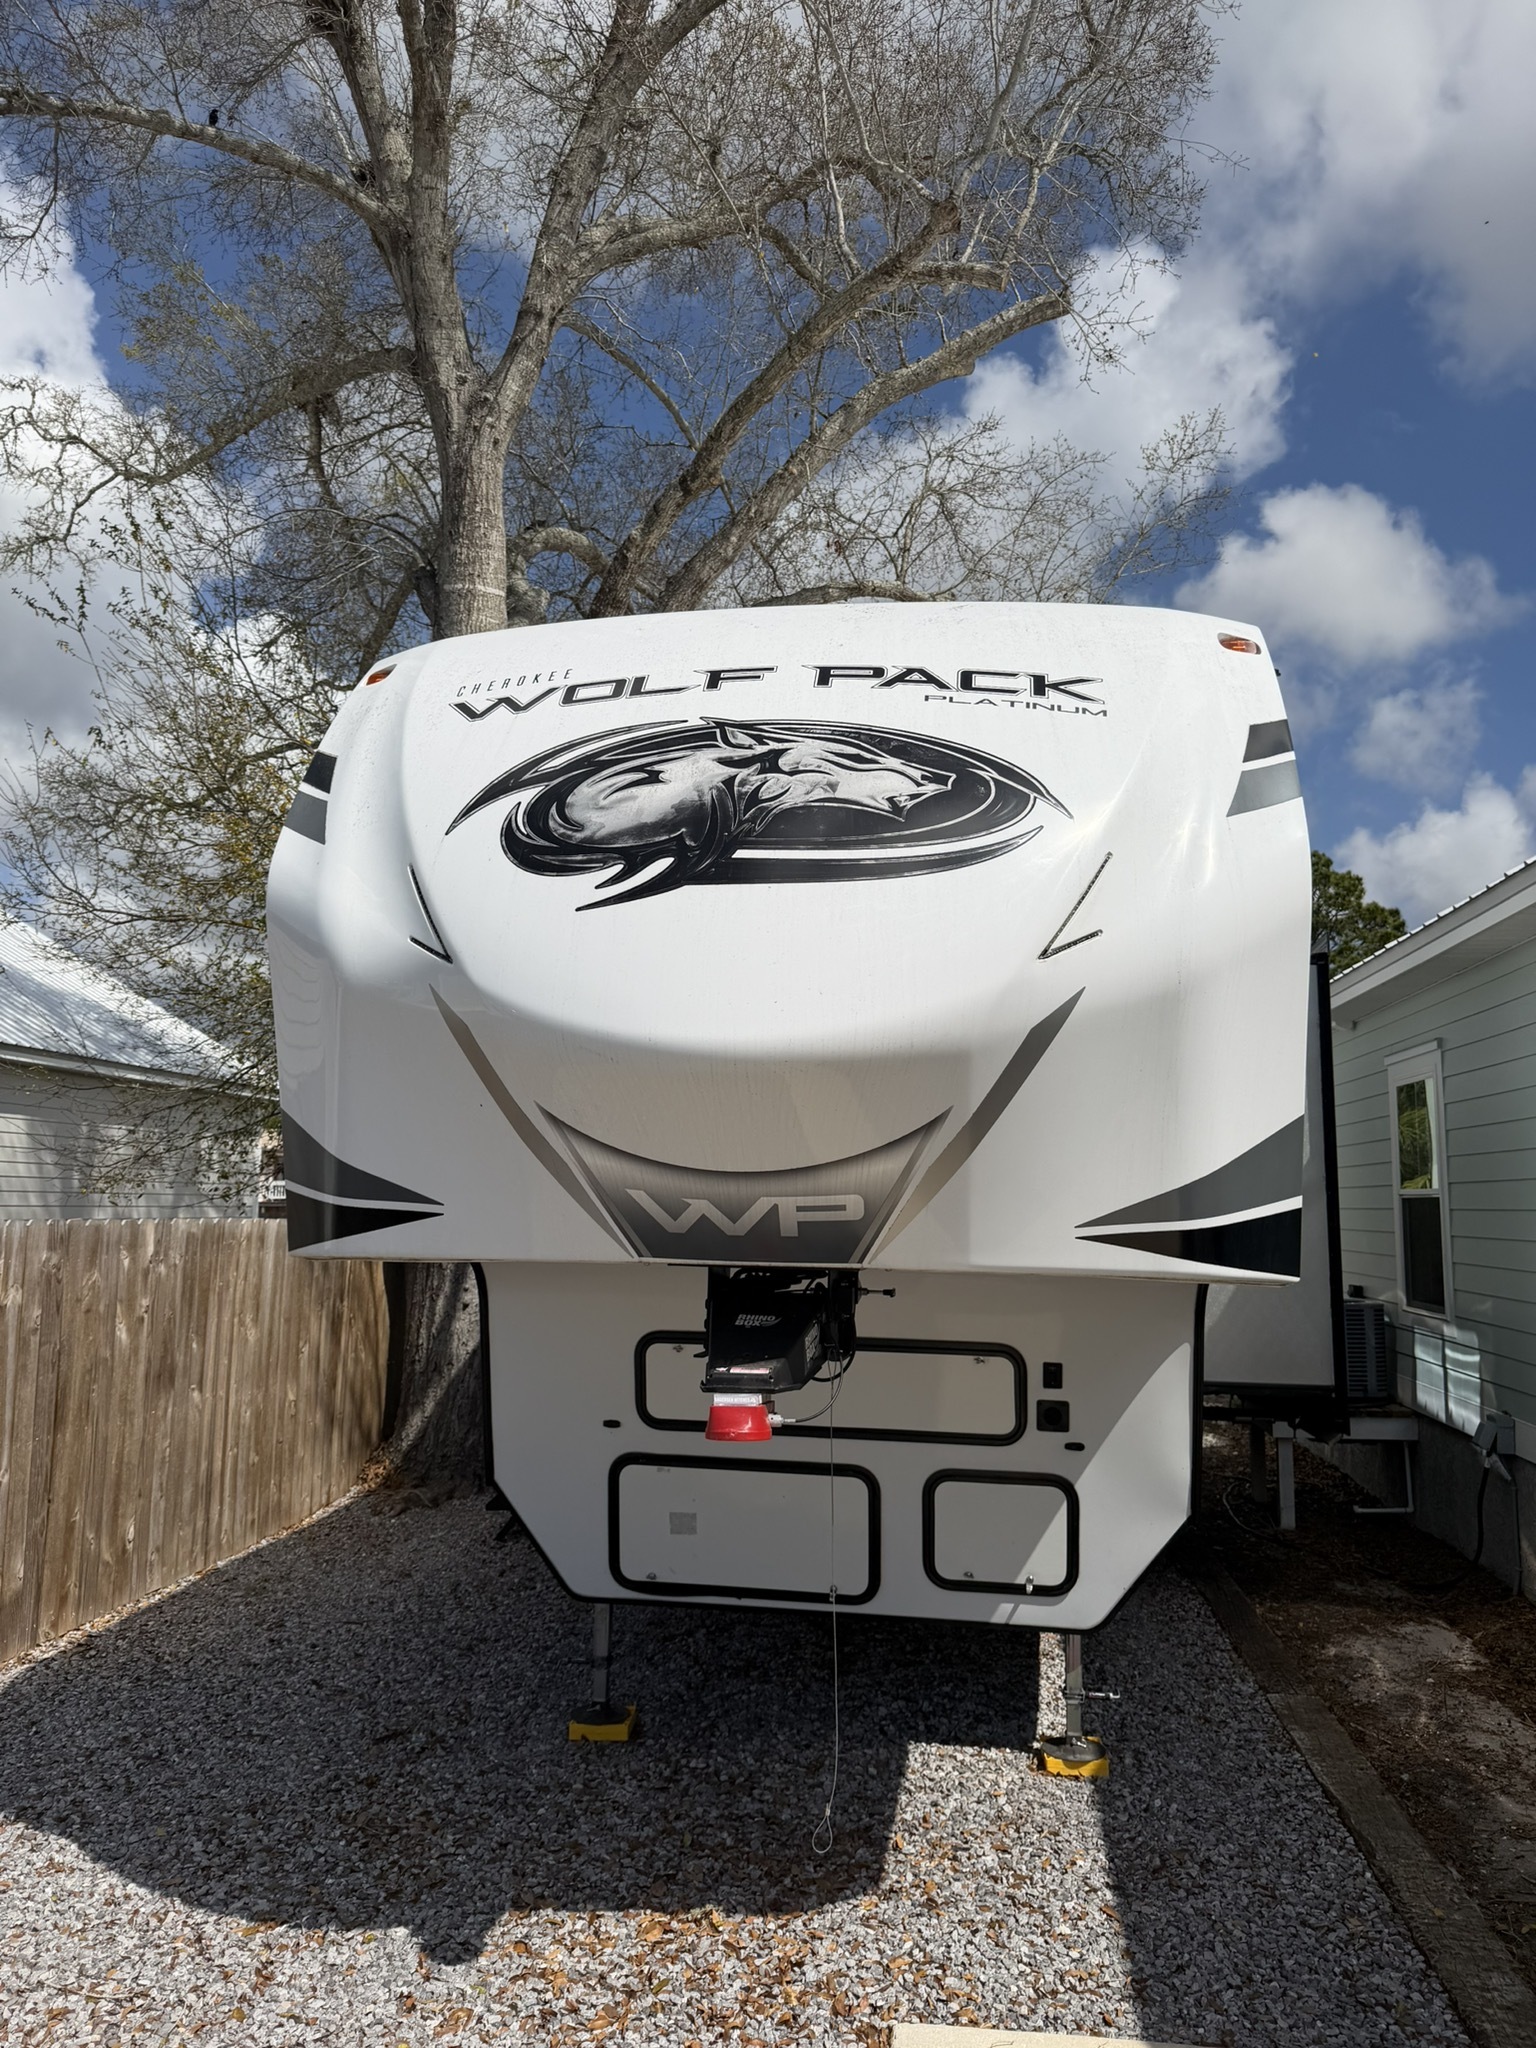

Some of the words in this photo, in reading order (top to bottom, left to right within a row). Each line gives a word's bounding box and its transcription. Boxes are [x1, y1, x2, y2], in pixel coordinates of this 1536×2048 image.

[448, 665, 779, 722] WOLF
[801, 664, 1106, 705] PACK
[456, 668, 573, 698] CHEROKEE
[924, 694, 1108, 717] PLATINUM
[624, 1188, 865, 1238] WP
[734, 1319, 761, 1327] BOX
[737, 1313, 777, 1321] RHINO
